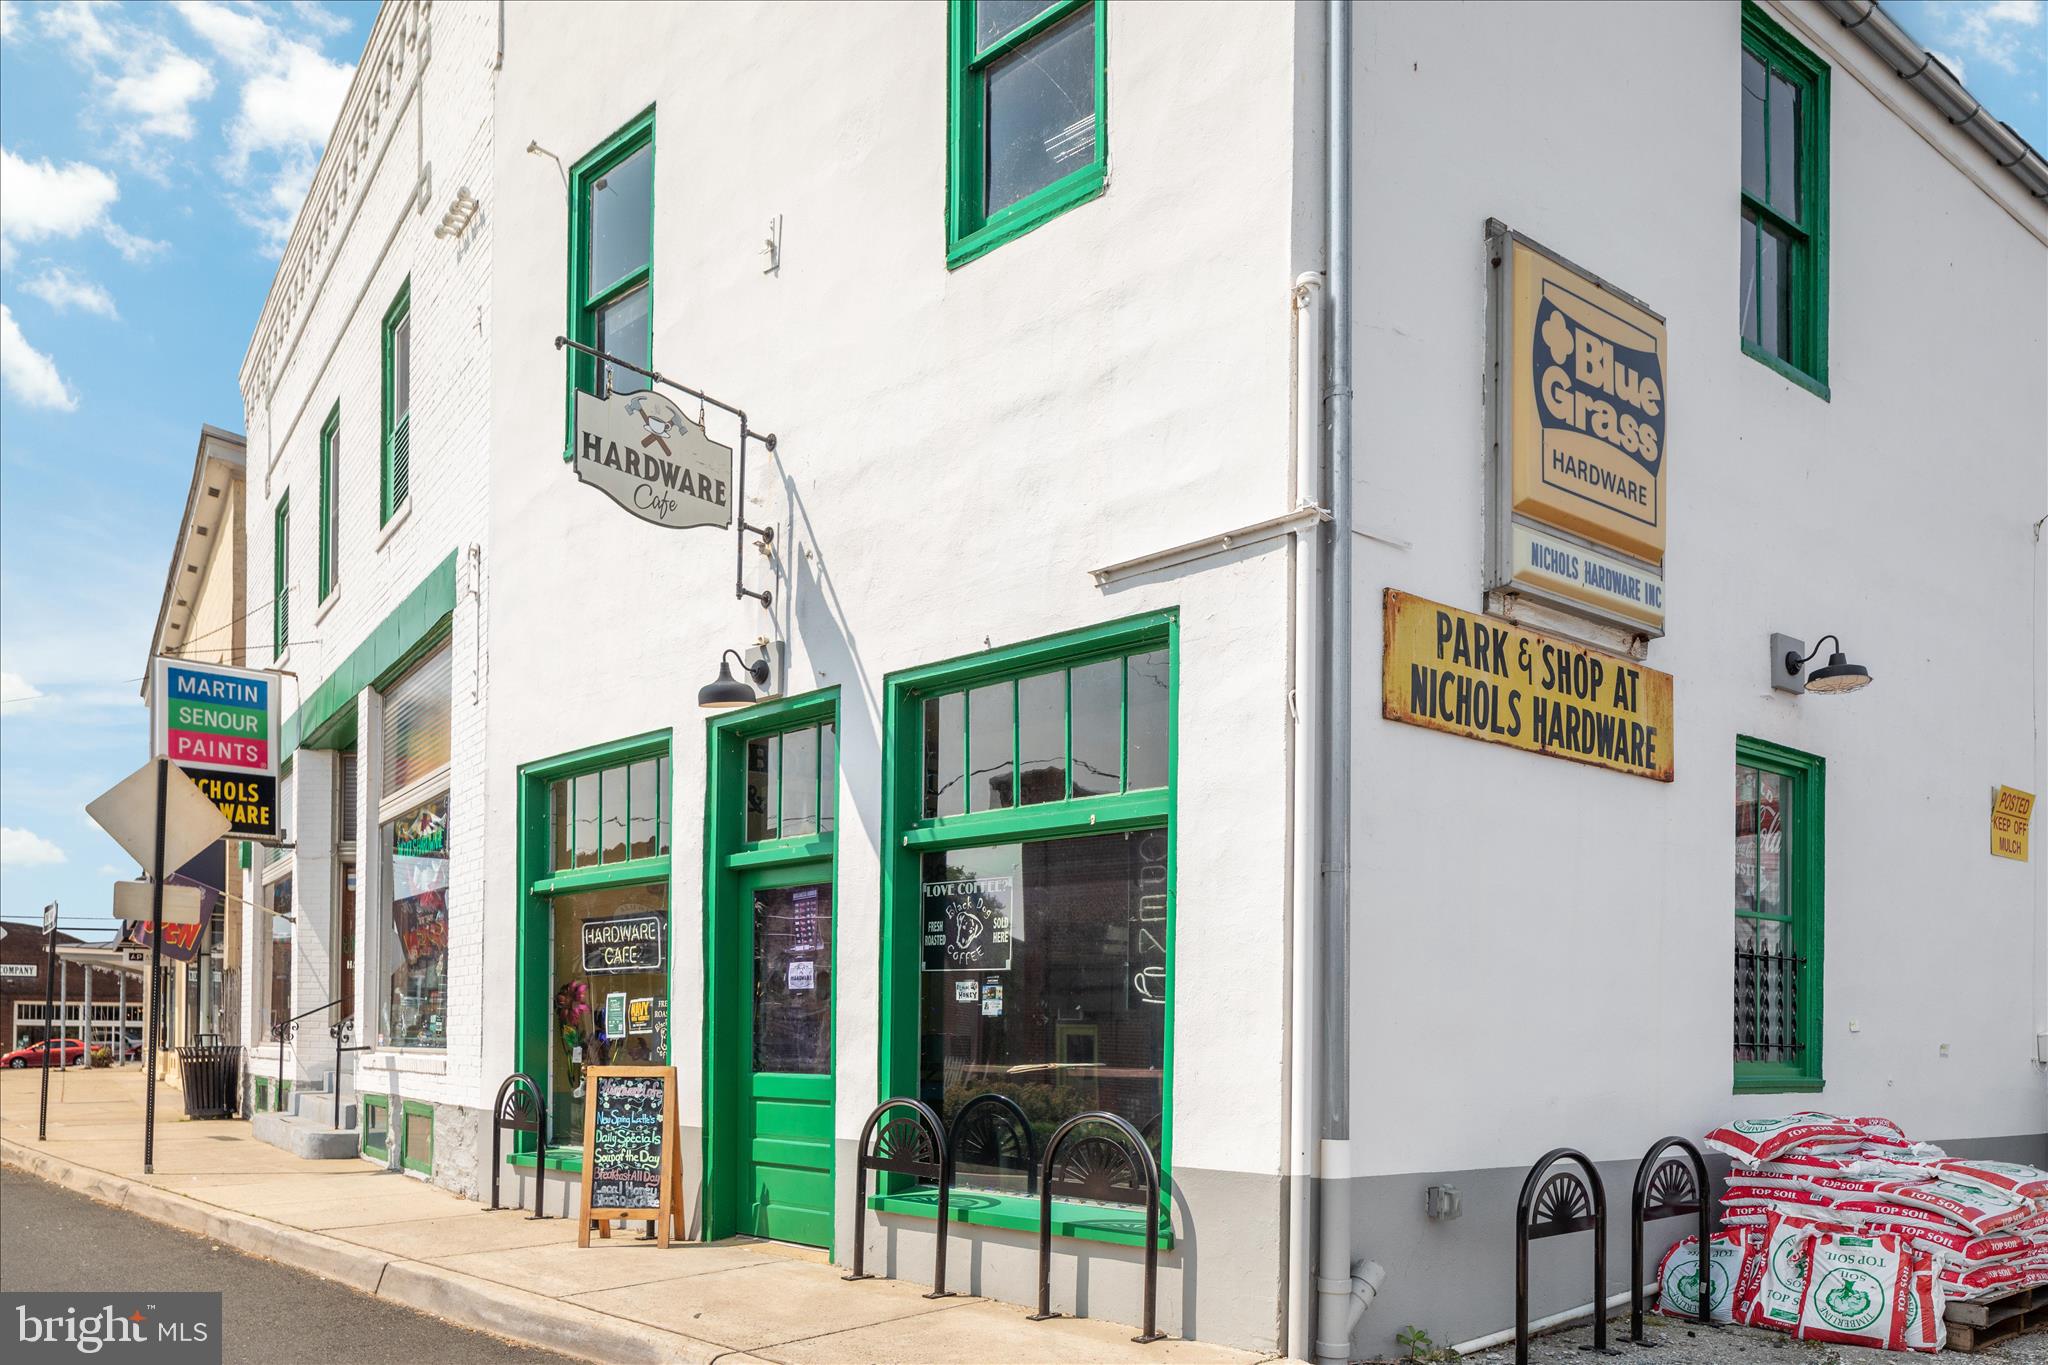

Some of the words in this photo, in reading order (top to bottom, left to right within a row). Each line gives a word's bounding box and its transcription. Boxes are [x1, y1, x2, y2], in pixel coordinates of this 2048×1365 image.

[1575, 327, 1661, 416] Blue
[1542, 365, 1658, 461] Grass
[582, 430, 726, 507] HARDWARE
[1553, 449, 1647, 506] HARDWARE
[634, 483, 678, 520] Cafe
[1531, 542, 1579, 580] NICHOLS
[1584, 560, 1640, 601] HARDWARE
[1645, 582, 1662, 608] INC
[1436, 610, 1509, 678] PARK
[1518, 637, 1533, 685] &
[1541, 644, 1604, 702] SHOP
[1613, 666, 1640, 713] AT
[177, 675, 258, 703] MARTIN
[179, 707, 258, 732] SENOUR
[1411, 663, 1522, 737] NICHOLS
[1533, 696, 1658, 770] HARDWARE
[178, 737, 258, 762] PAINTS
[192, 778, 259, 802] CHOLS
[1999, 792, 2030, 815] POSTED
[1993, 816, 2011, 832] KEEP
[2014, 820, 2028, 836] OFF
[1999, 837, 2022, 854] MULCH
[926, 883, 955, 897] LOVE
[957, 880, 1008, 895] COFFEE?
[946, 896, 972, 919] Black
[977, 897, 992, 919] Dog
[585, 921, 656, 945] HARDWARE
[928, 921, 943, 932] FRESH
[993, 917, 1009, 929] SOLD
[925, 934, 946, 946] ROASTED
[993, 931, 1009, 943] HERE
[604, 945, 637, 965] CAFE
[596, 1130, 617, 1148] Daily
[618, 1129, 661, 1146] Specials
[1788, 1127, 1808, 1138] TOP
[594, 1149, 615, 1165] Soup
[615, 1148, 625, 1161] of
[625, 1150, 639, 1161] the
[640, 1150, 660, 1168] Day
[594, 1167, 631, 1181] Breakfast
[631, 1170, 643, 1181] All
[643, 1171, 660, 1187] Day
[1762, 1171, 1785, 1179] SOIL
[1822, 1179, 1841, 1188] TOP
[1841, 1182, 1865, 1191] SOIL
[1751, 1188, 1770, 1196] TOP
[1773, 1190, 1798, 1200] SOIL
[1911, 1191, 1935, 1201] TOP
[1936, 1199, 1964, 1215] SOIL
[1875, 1205, 1899, 1214] TOP
[1901, 1208, 1929, 1220] SOIL
[2001, 1216, 2013, 1226] TOP
[1901, 1225, 1925, 1236] TOP
[1926, 1232, 1953, 1247] SOIL
[1991, 1241, 2004, 1250] TOP
[2004, 1240, 2017, 1249] SOIL
[1744, 1256, 1754, 1277] SOIL
[1824, 1251, 1855, 1264] SOIL
[1857, 1256, 1886, 1268] TOP
[1840, 1270, 1866, 1282] SOIL
[1900, 1265, 1910, 1288] SOIL
[1738, 1281, 1748, 1298] TOP
[1767, 1290, 1791, 1302] TOP
[1897, 1289, 1906, 1312] TOP
[1820, 1306, 1875, 1328] TIMBERLINE
